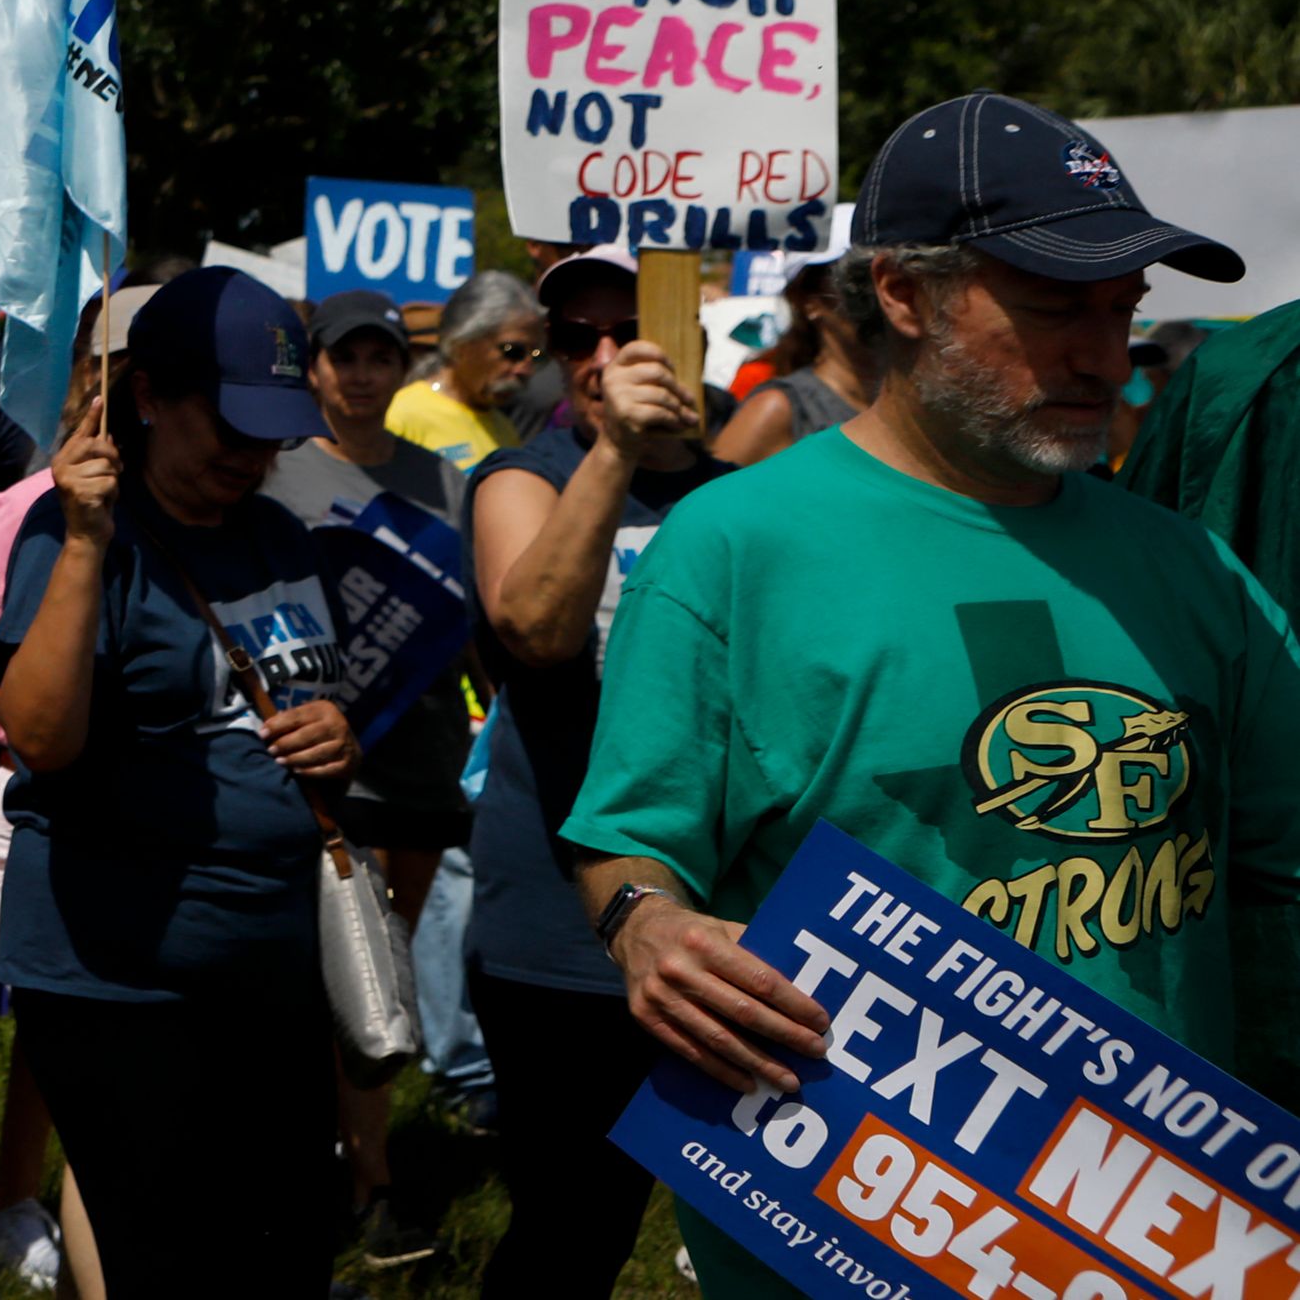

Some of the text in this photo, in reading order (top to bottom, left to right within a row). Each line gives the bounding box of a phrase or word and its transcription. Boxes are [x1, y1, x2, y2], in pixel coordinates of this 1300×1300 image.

[526, 3, 823, 101] PEACE,
[526, 88, 663, 150] NOT
[568, 195, 827, 252] DRILLS
[576, 149, 830, 204] CODE RED
[314, 194, 474, 290] VOTE
[223, 602, 326, 658] ARCH
[793, 928, 1048, 1155] TEXT
[828, 871, 942, 965] THE
[925, 938, 1135, 1086] FIGHT'S
[1123, 1063, 1259, 1158] NOT
[681, 1140, 914, 1300] and stay invol
[731, 1077, 1129, 1300] to 954-
